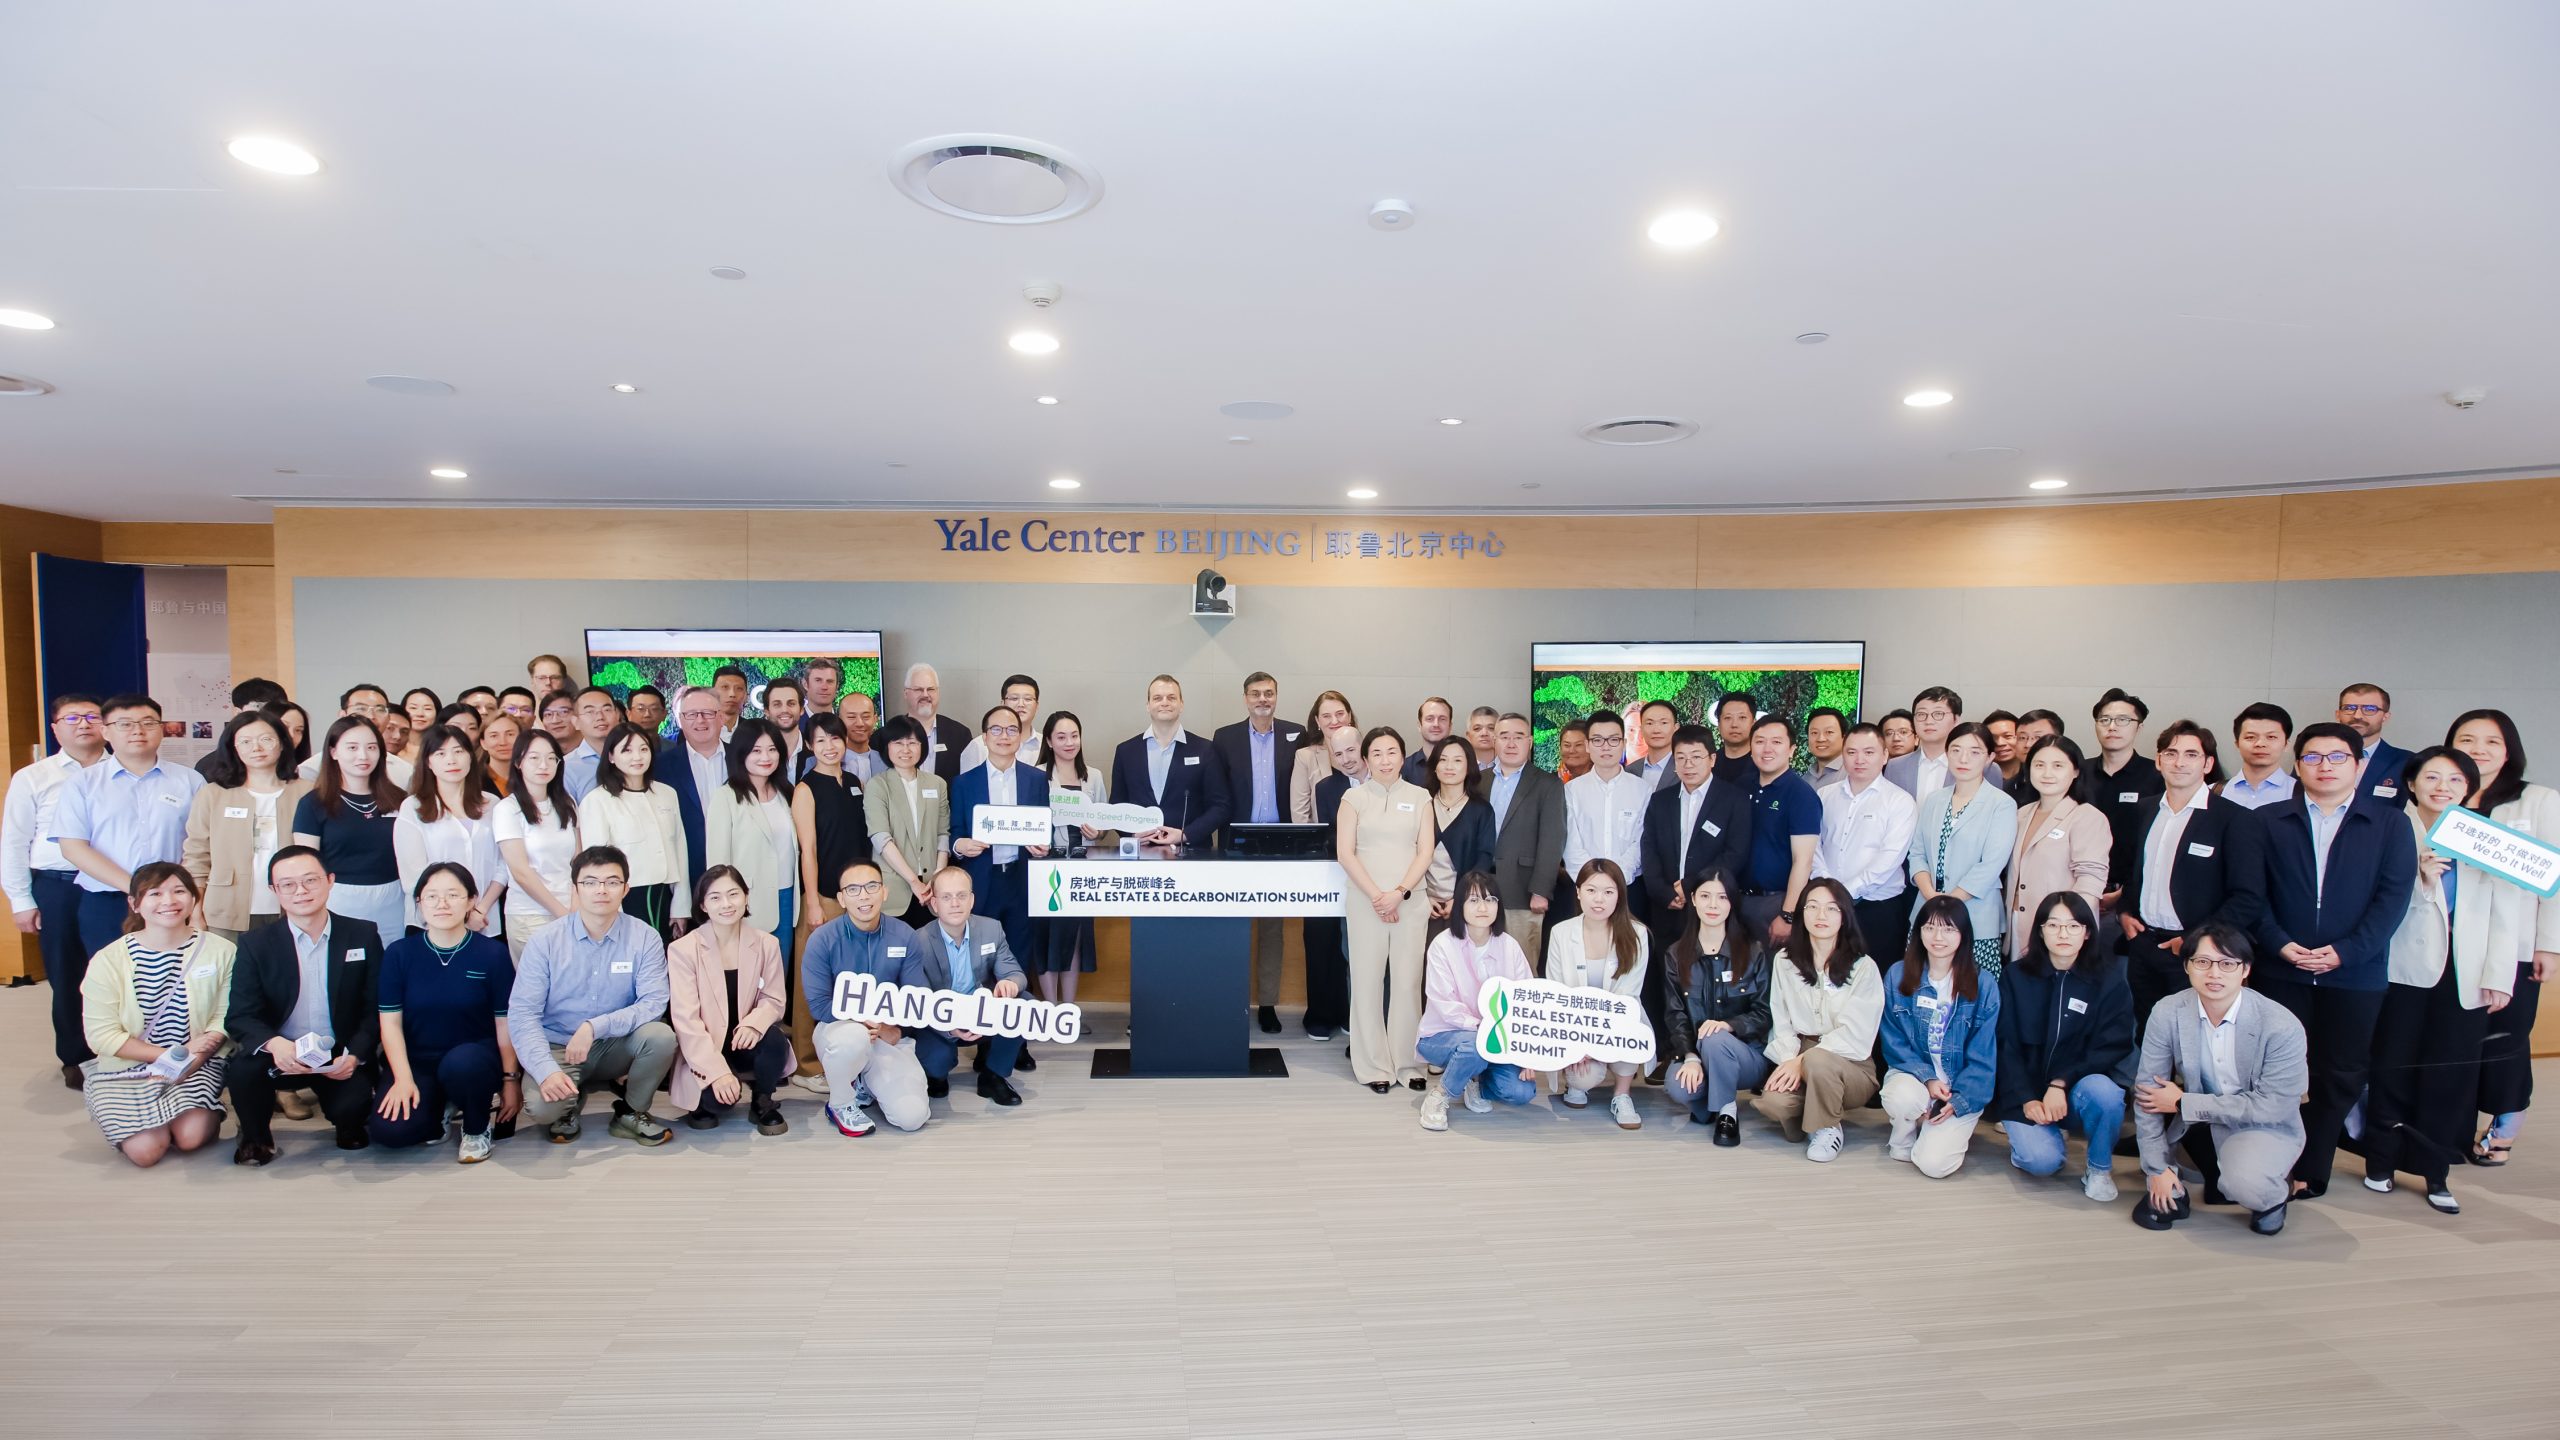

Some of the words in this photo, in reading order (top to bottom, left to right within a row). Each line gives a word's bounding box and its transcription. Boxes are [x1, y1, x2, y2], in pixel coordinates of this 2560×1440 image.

[934, 518, 1011, 553] Yale
[1020, 519, 1144, 554] Center
[1155, 530, 1300, 561] BEIJING
[1324, 530, 1506, 559] 耶鲁北京中心
[1059, 809, 1085, 818] Forces
[1087, 811, 1095, 819] to
[1097, 812, 1123, 823] Speed
[1125, 814, 1159, 826] Progress
[2453, 821, 2501, 847] 只选好的
[2472, 842, 2490, 856] We
[2491, 851, 2508, 864] Do
[2509, 858, 2519, 868] It
[2520, 864, 2546, 880] Well
[1070, 876, 1176, 890] 房地产与脱碳峰会
[1070, 891, 1101, 902] REAL
[1105, 891, 1150, 902] ESTATE
[1152, 891, 1161, 902] &
[1164, 891, 1289, 903] DECARBONIZATION
[1290, 892, 1340, 903] SUMMIT
[840, 979, 954, 1024] HANG
[976, 995, 1075, 1036] LUNG
[1512, 988, 1628, 1015] 房地产与脱碳峰会
[1512, 1006, 1547, 1021] REAL
[1550, 1011, 1599, 1028] ESTATE
[1602, 1018, 1612, 1030] &
[1510, 1040, 1567, 1058] SUMMIT
[1511, 1022, 1649, 1051] DECARBONIZATION
